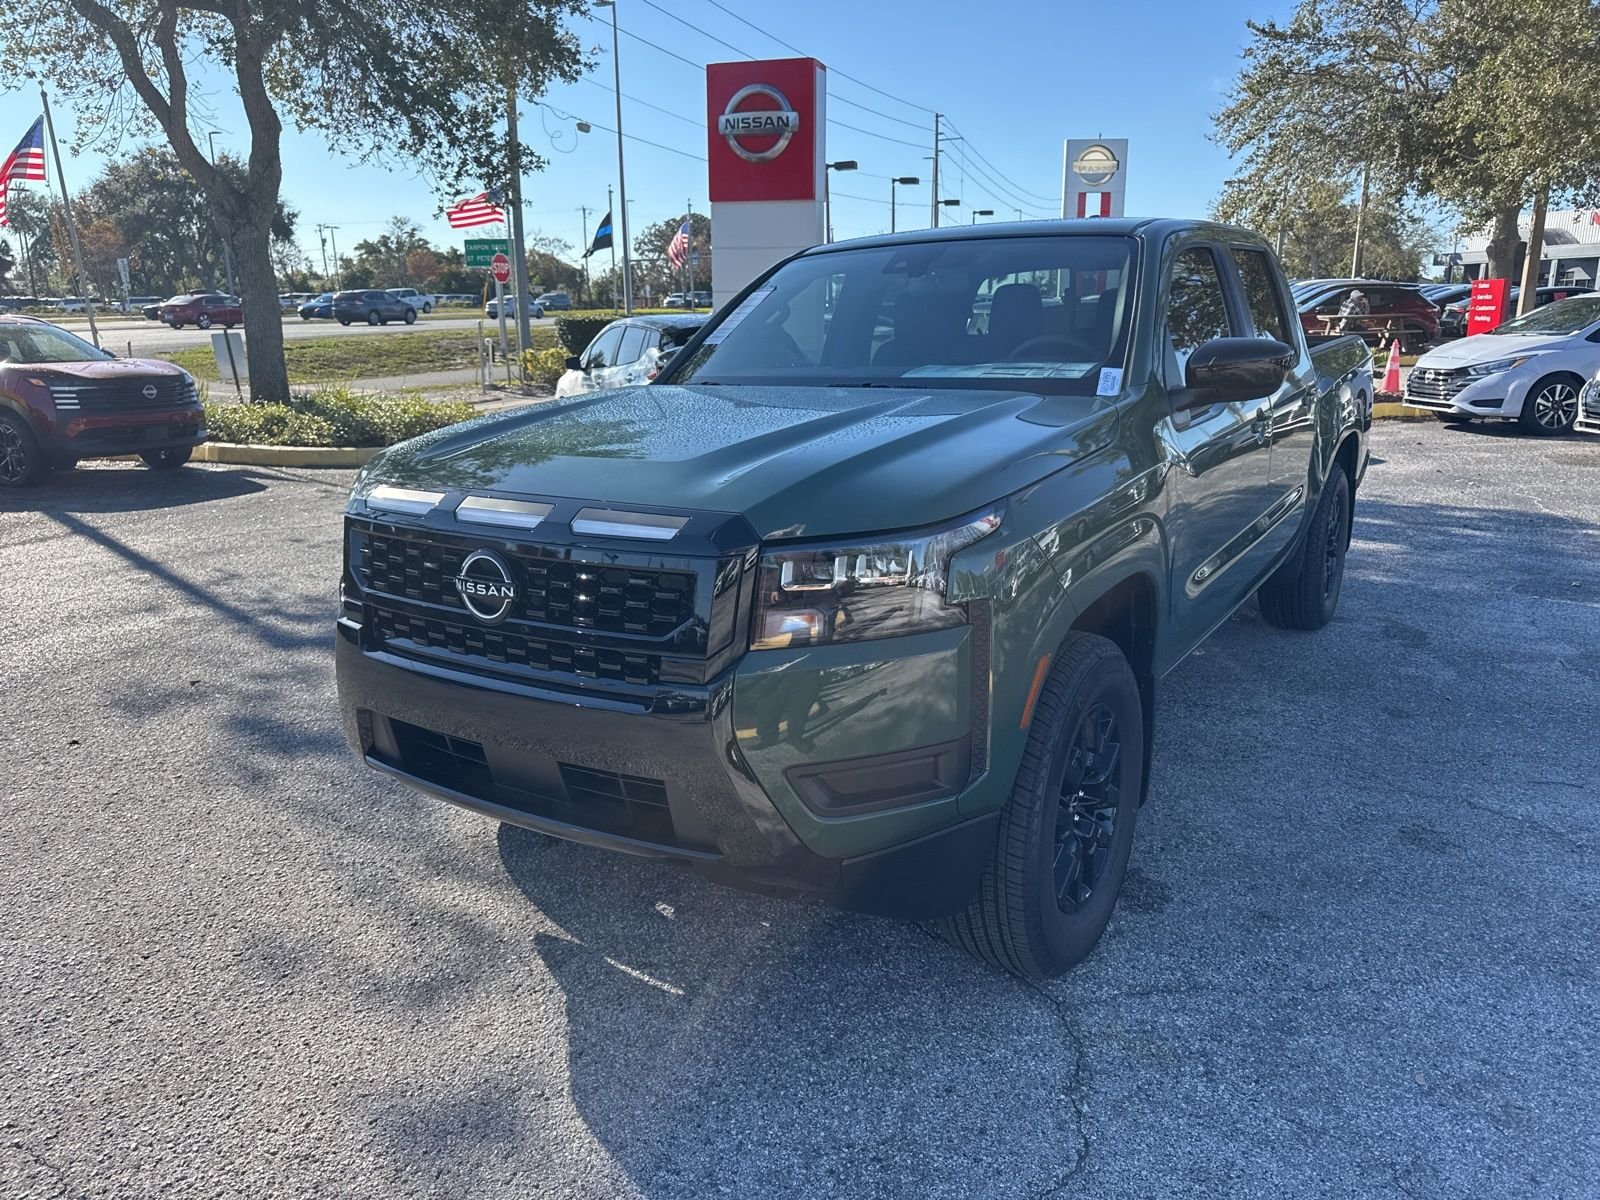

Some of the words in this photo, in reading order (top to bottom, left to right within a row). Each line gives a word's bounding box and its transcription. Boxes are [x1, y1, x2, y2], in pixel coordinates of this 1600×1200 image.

[725, 115, 790, 130] NISSAN
[493, 262, 509, 274] STOP
[455, 579, 514, 597] NISSAN
